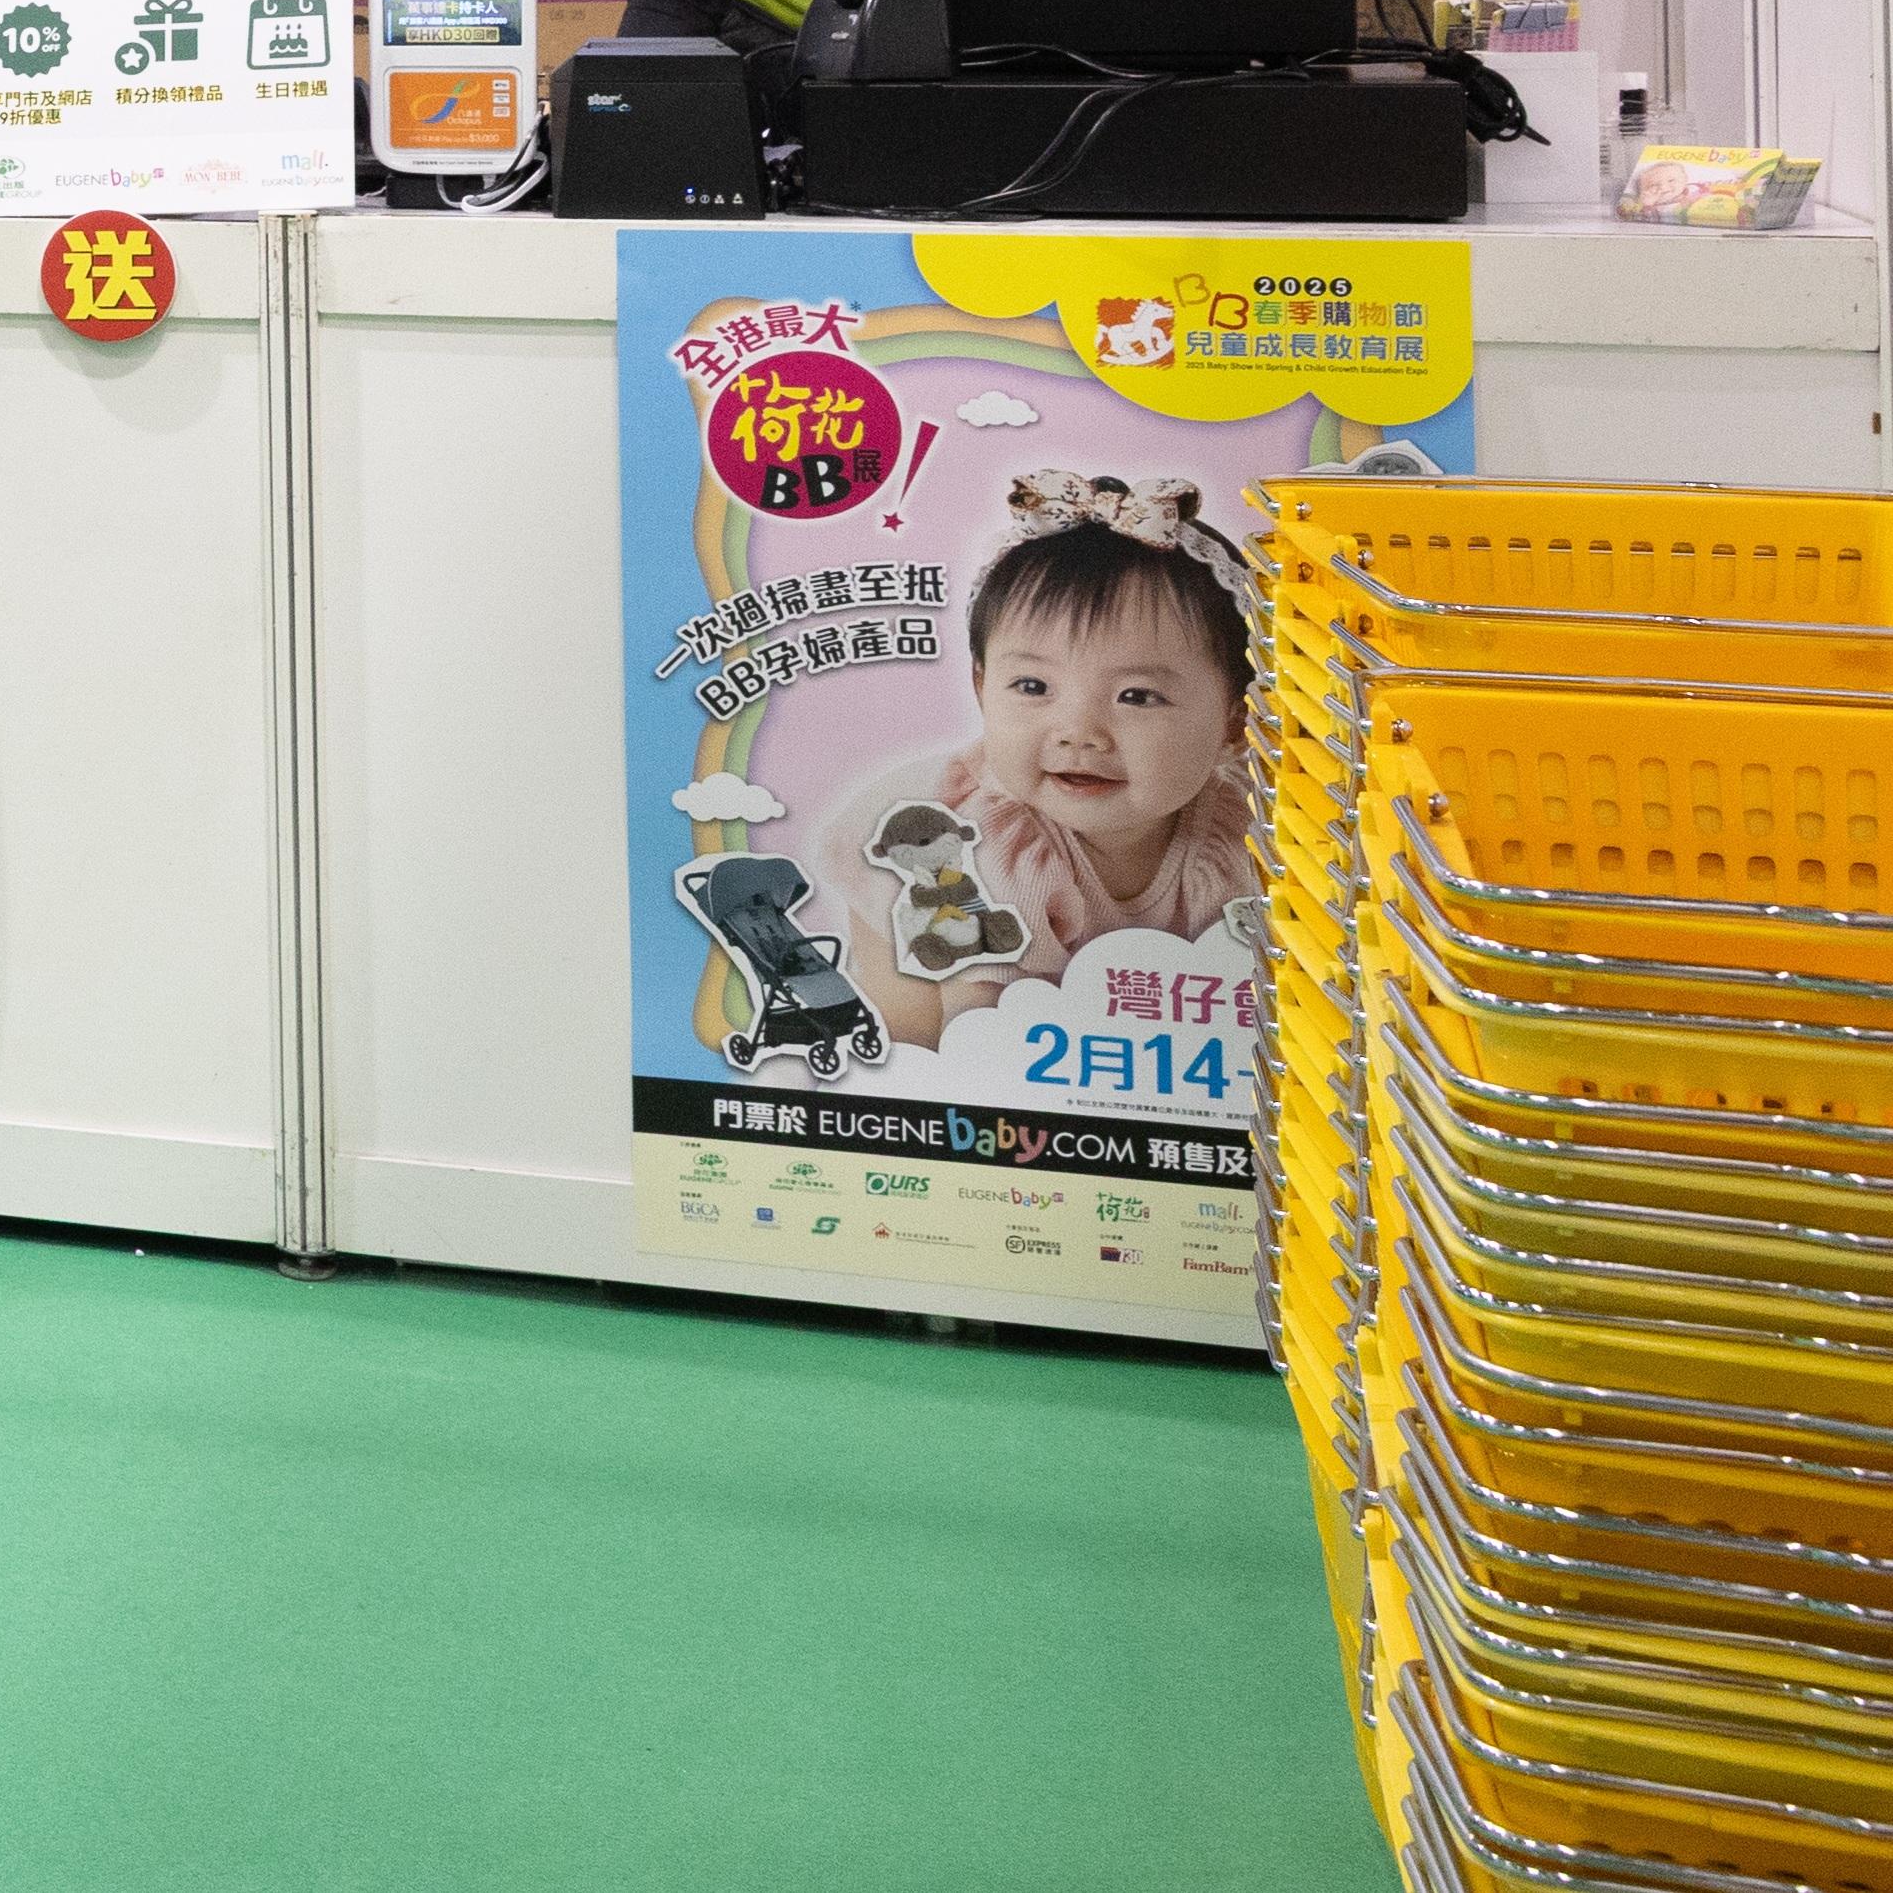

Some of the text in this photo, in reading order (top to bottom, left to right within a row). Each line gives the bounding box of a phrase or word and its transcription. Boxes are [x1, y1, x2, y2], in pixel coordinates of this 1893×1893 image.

[116, 84, 223, 105] 積分換領禮品
[256, 80, 329, 100] 生日禮遇
[0, 108, 62, 126] 9折優惠
[62, 230, 157, 320] 送
[1254, 276, 1353, 297] 2025
[670, 301, 861, 392] 全港最大
[1185, 331, 1425, 362] 兒童成長教育展
[730, 377, 866, 467] 荷花
[655, 563, 946, 679] 一次過掃盡至抵
[697, 618, 939, 721] BB孕婦產品
[714, 1095, 807, 1135] 門票於
